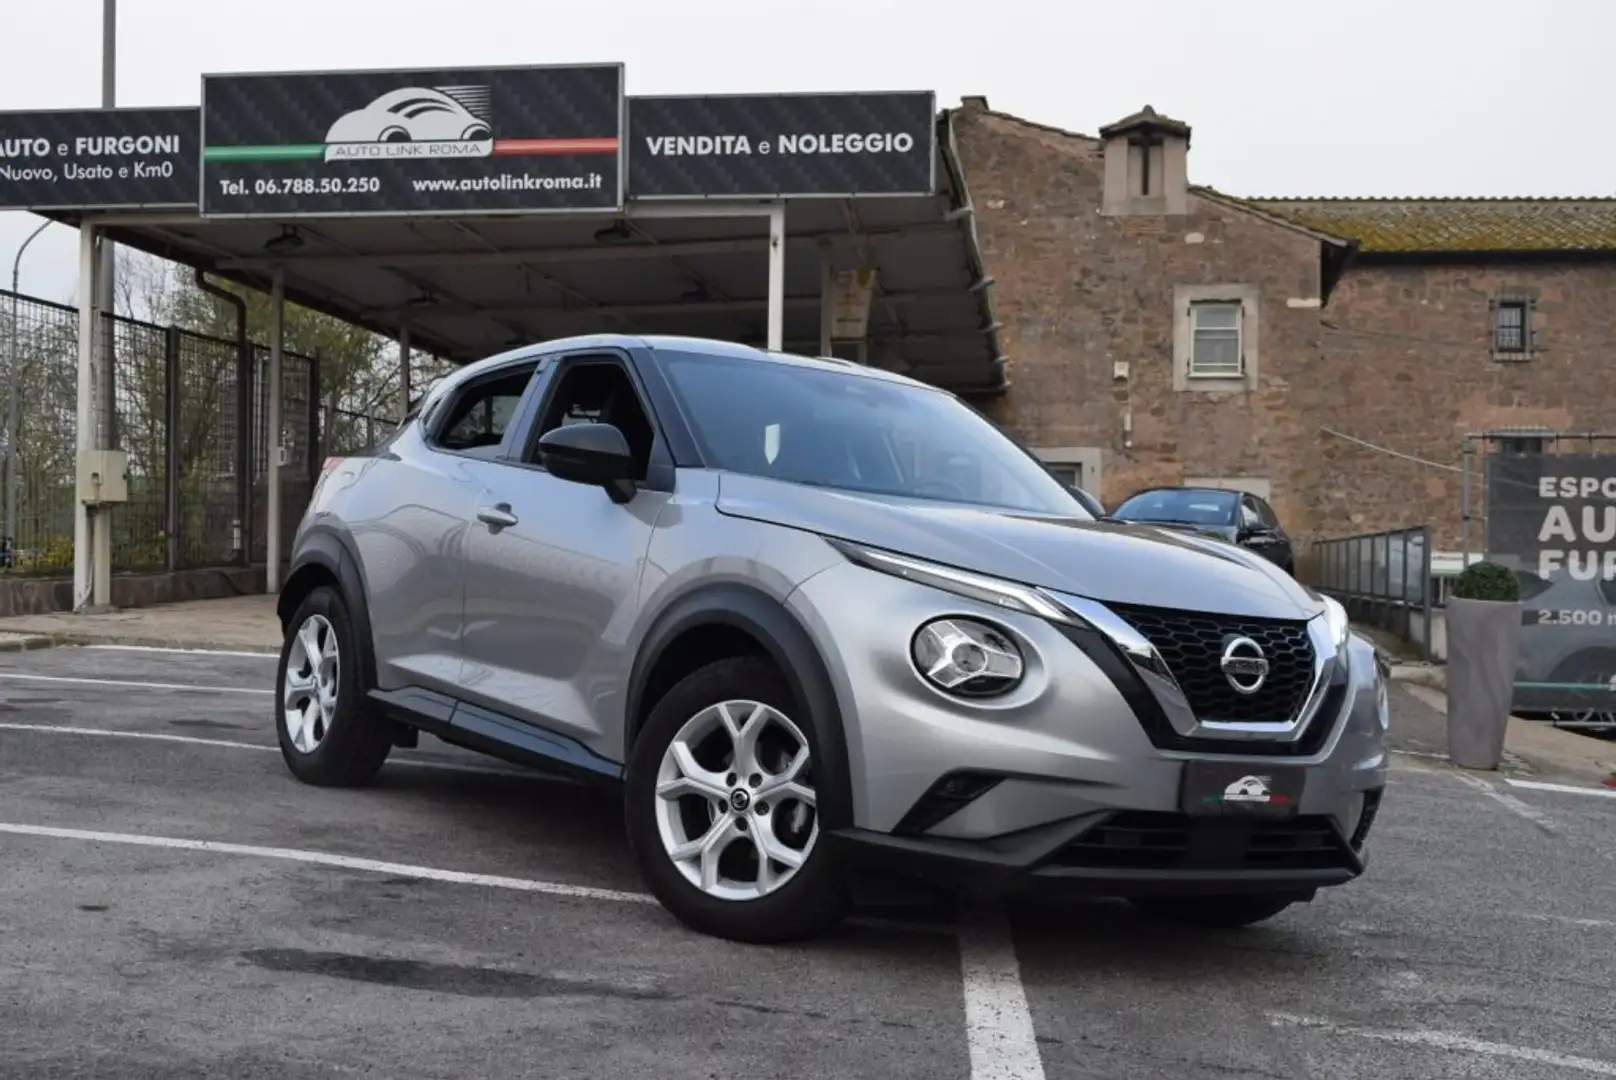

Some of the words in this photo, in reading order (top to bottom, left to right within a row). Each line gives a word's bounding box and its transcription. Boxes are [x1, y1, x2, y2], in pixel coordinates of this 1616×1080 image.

[57, 143, 69, 156] e
[76, 135, 180, 155] FURGONI
[335, 145, 381, 157] AUTO
[386, 144, 423, 156] LINK
[429, 143, 481, 155] ROMA
[646, 135, 752, 155] VENDITA
[758, 141, 771, 154] e
[778, 133, 914, 153] NOLEGGIO
[64, 162, 113, 179] Usato
[118, 166, 129, 178] e
[134, 161, 173, 178] Km0
[220, 179, 249, 195] Tel.
[255, 177, 380, 194] 06.788.50.250
[412, 173, 602, 192] www.autolinkroma.it
[1538, 608, 1602, 626] 2.500
